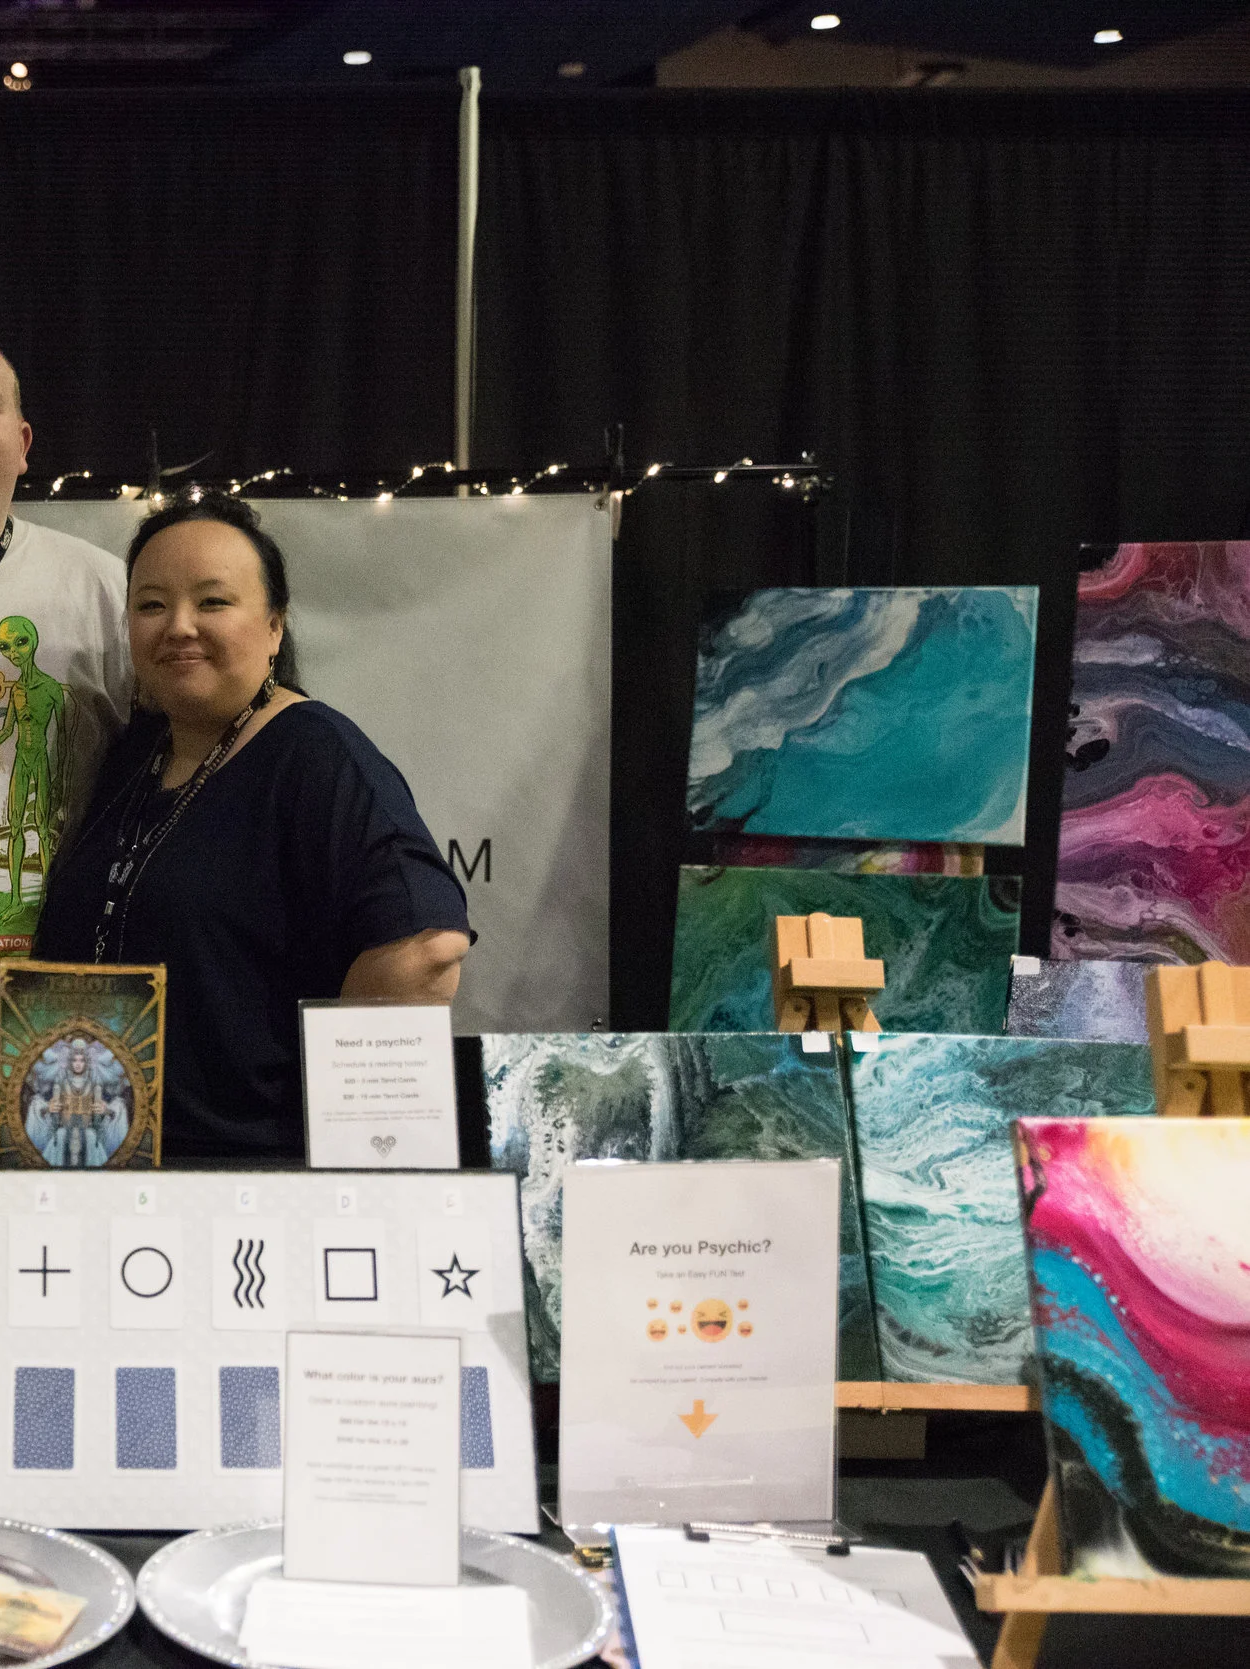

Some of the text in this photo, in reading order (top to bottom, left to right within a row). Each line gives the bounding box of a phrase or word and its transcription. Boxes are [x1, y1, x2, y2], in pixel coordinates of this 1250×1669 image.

[335, 1038, 363, 1048] Need
[375, 1037, 422, 1049] psychic?
[630, 1240, 772, 1258] Are you Psychic?
[688, 1271, 707, 1280] Easy
[709, 1270, 727, 1278] FUN
[304, 1370, 444, 1385] What color is your aura?
